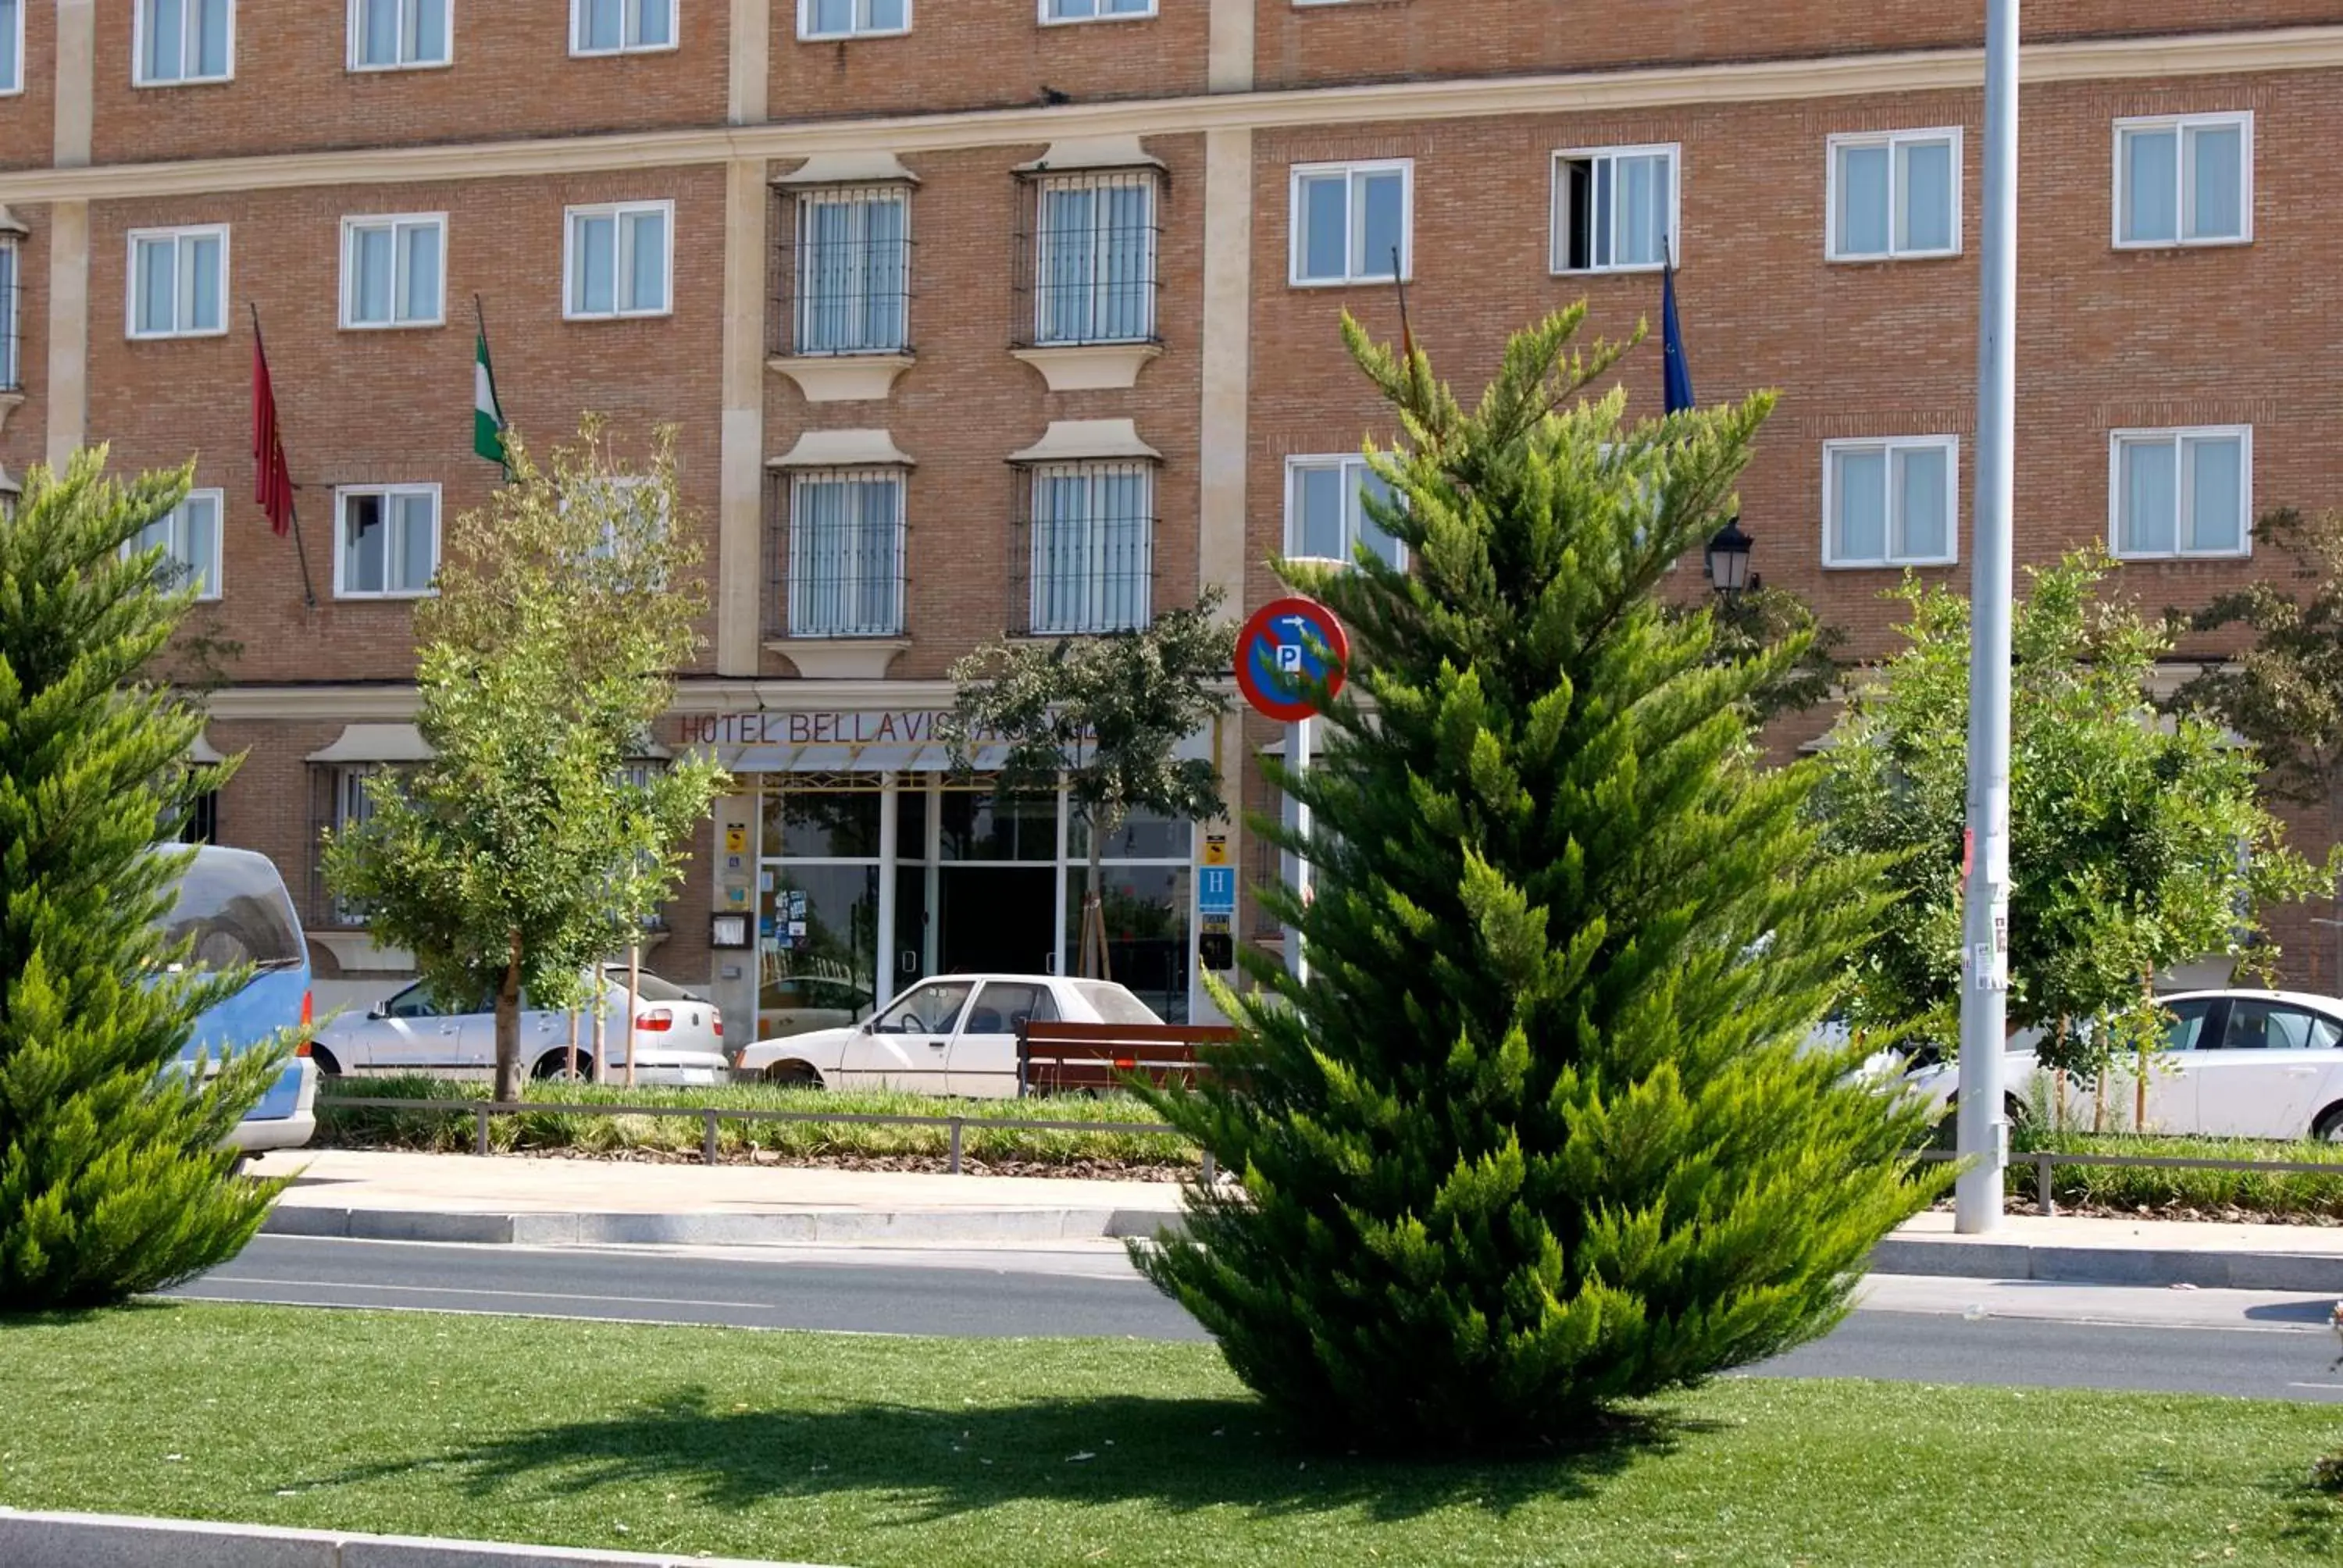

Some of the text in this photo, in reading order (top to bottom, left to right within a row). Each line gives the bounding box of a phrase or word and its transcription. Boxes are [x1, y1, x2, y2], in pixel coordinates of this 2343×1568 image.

[1282, 647, 1297, 668] P
[679, 713, 777, 744] HOTEL
[790, 711, 997, 743] BELLAVISA
[1208, 871, 1225, 893] H
